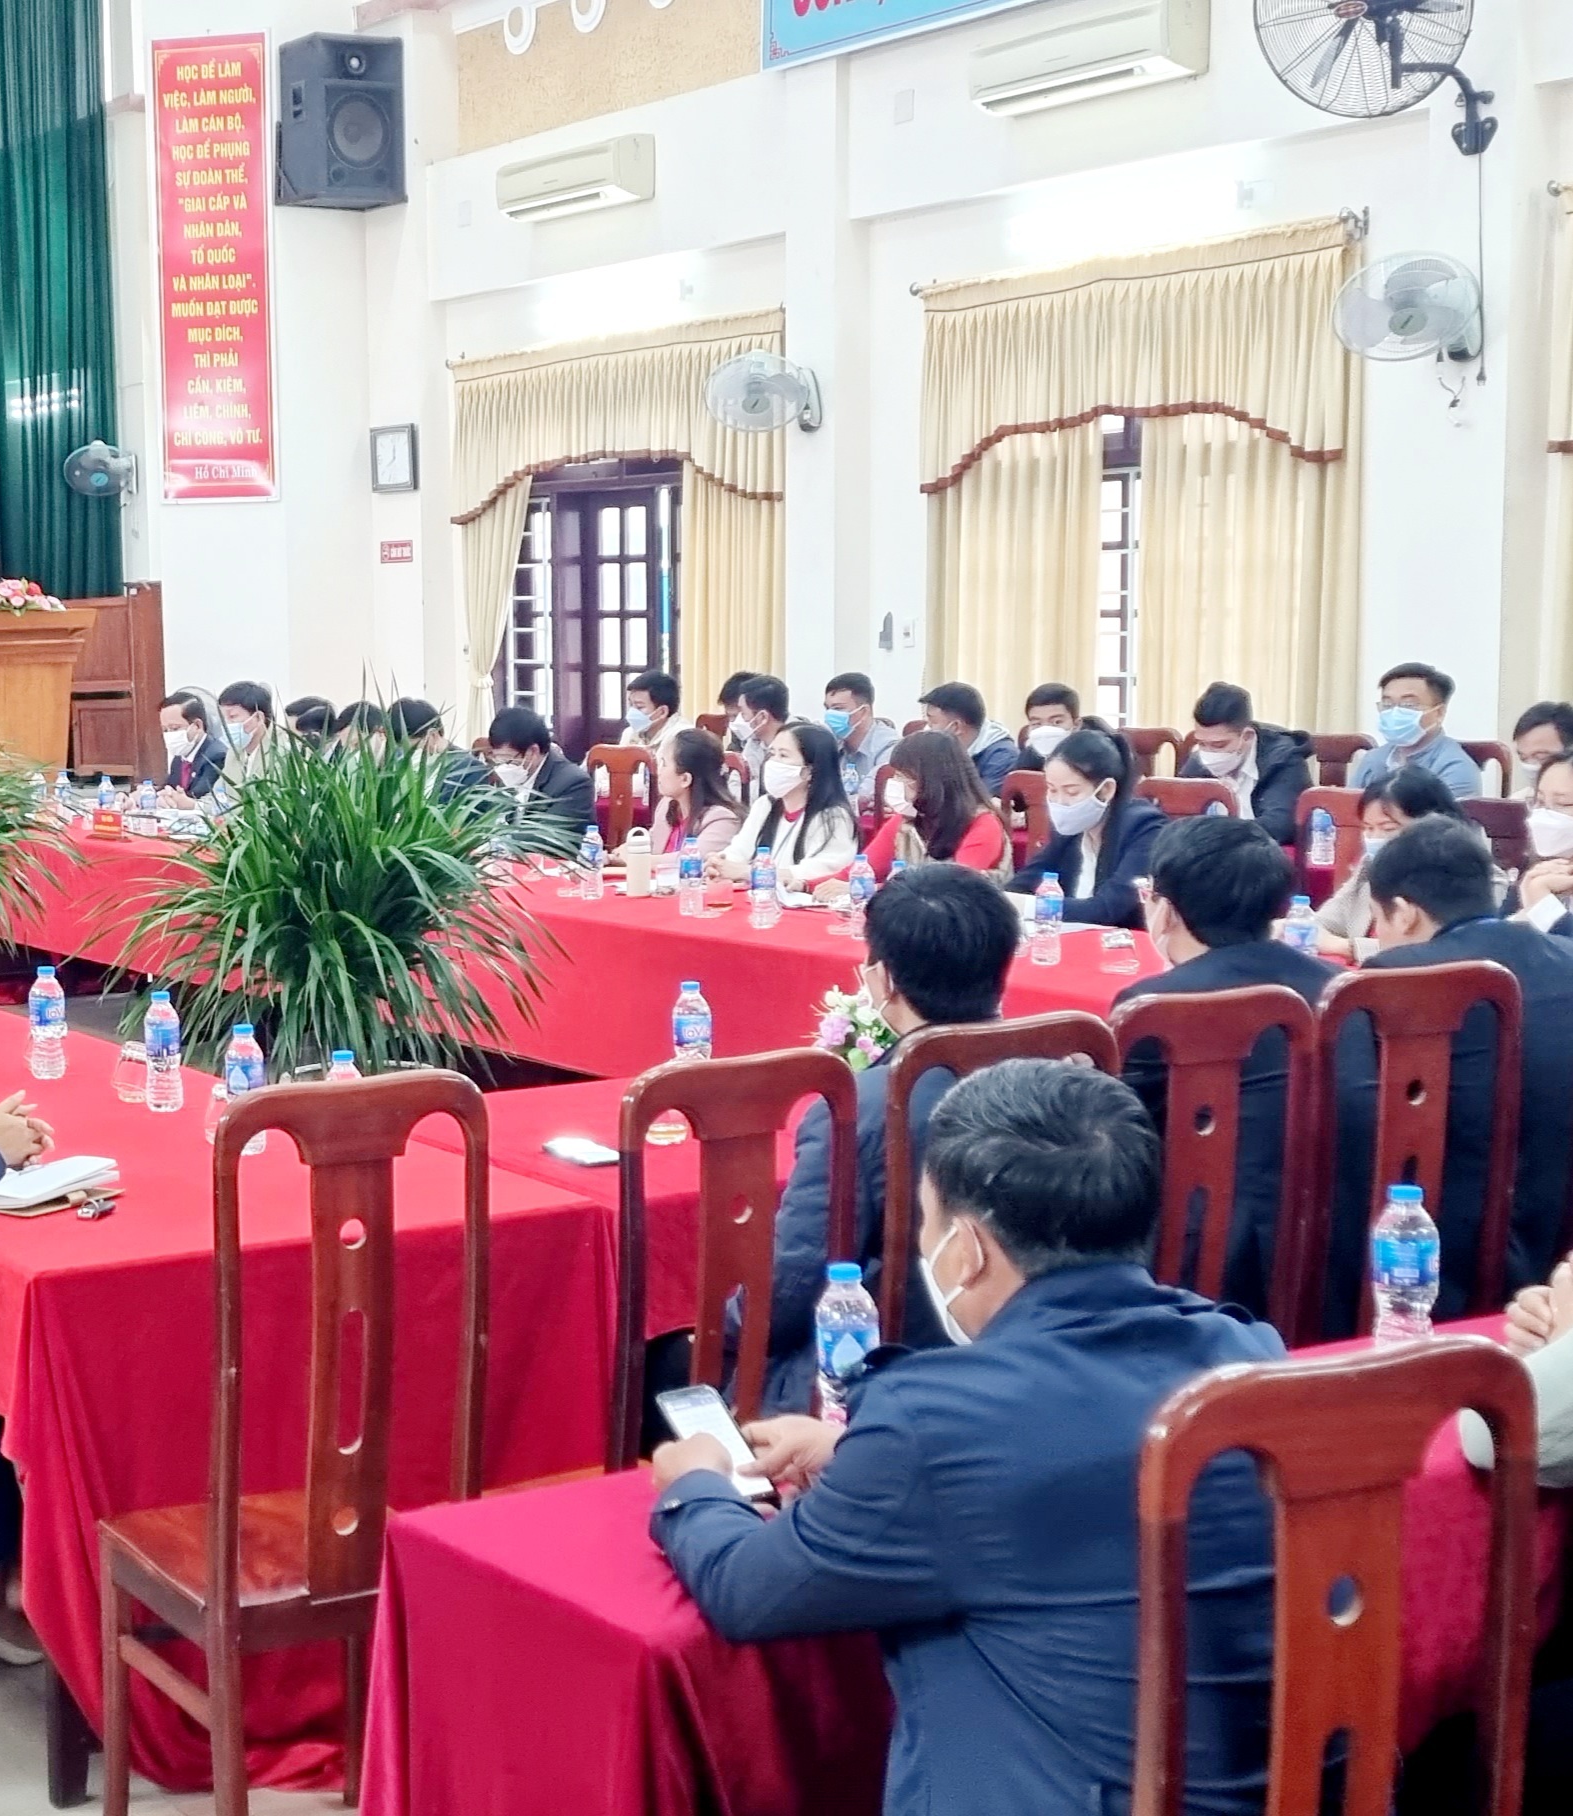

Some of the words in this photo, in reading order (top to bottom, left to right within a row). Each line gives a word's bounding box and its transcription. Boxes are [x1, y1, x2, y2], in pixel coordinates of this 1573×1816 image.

[176, 64, 199, 83] HỌC
[201, 58, 216, 79] ĐỂ
[218, 60, 242, 78] LÀM
[163, 90, 191, 109] VIỆC,
[193, 87, 217, 107] LÀM
[175, 115, 200, 134] LÀM
[202, 114, 224, 132] CÁN
[172, 144, 194, 163] HỌC
[196, 138, 211, 159] ĐỂ
[213, 140, 250, 160] PHỤNG
[175, 169, 191, 189] SỰ
[193, 166, 223, 186] ĐOÀN
[178, 197, 206, 213] "GIAI
[209, 191, 230, 211] CẤP
[233, 191, 247, 210] VÀ
[184, 221, 214, 239] NHÂN
[216, 220, 242, 238] DÂN,
[208, 244, 236, 266] QUỐC
[173, 274, 187, 292] VÀ
[189, 272, 220, 292] NHÂN
[171, 298, 203, 318] MUỐN
[206, 302, 227, 320] ĐẠT
[229, 298, 258, 318] ĐƯỢC
[188, 327, 213, 346] MỤC
[214, 323, 243, 342] ĐÍCH,
[194, 350, 211, 369] THÌ
[213, 347, 238, 367] PHẢI
[174, 428, 192, 447] CHÍ
[229, 426, 243, 445] VÔ
[195, 464, 209, 480] Hồ
[211, 464, 229, 479] Chí
[232, 463, 258, 478] Minh
